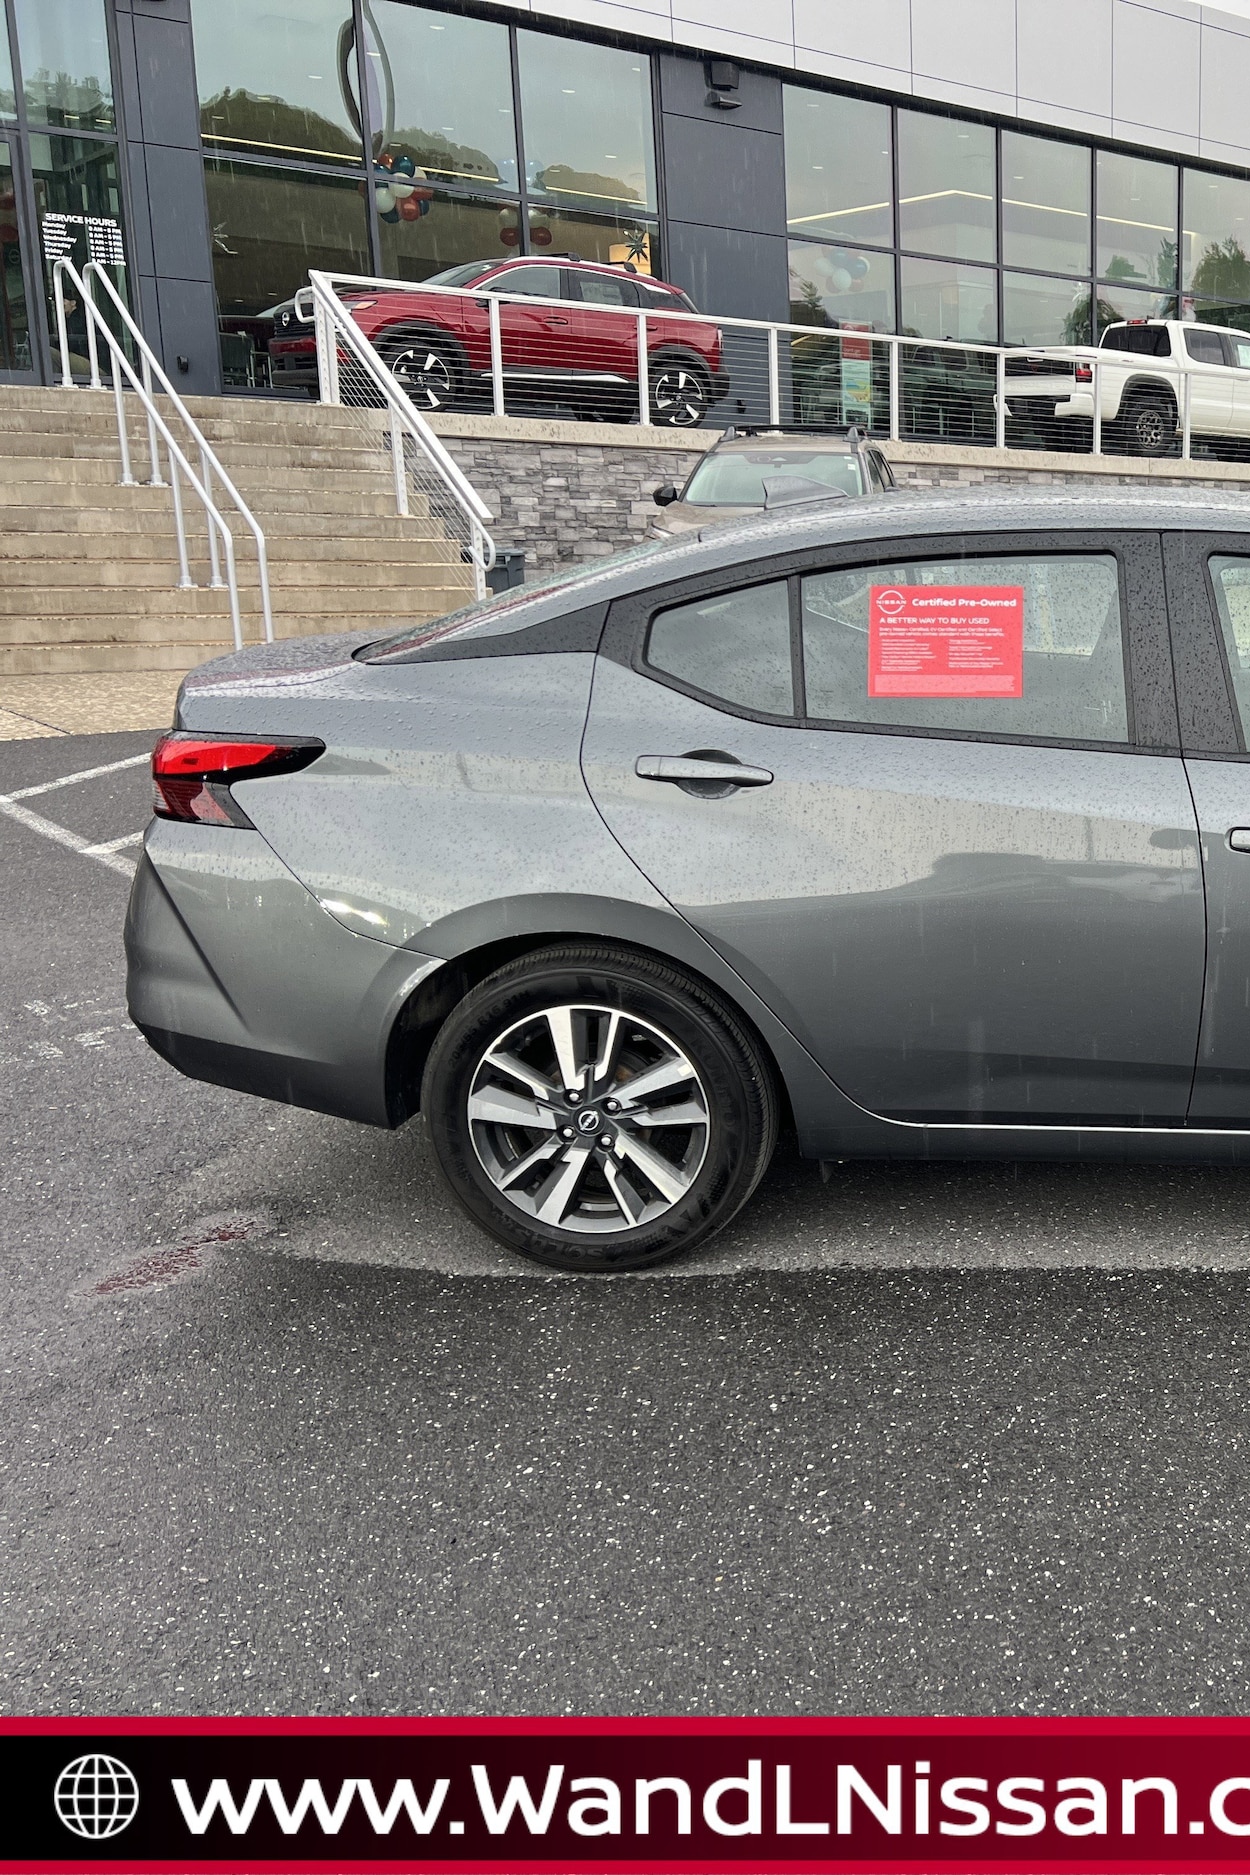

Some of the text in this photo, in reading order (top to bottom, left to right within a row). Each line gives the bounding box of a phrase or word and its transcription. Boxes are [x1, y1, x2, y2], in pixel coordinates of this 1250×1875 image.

[46, 213, 117, 227] SERVICE HOURS
[912, 598, 1016, 607] Certified Pre-Owned
